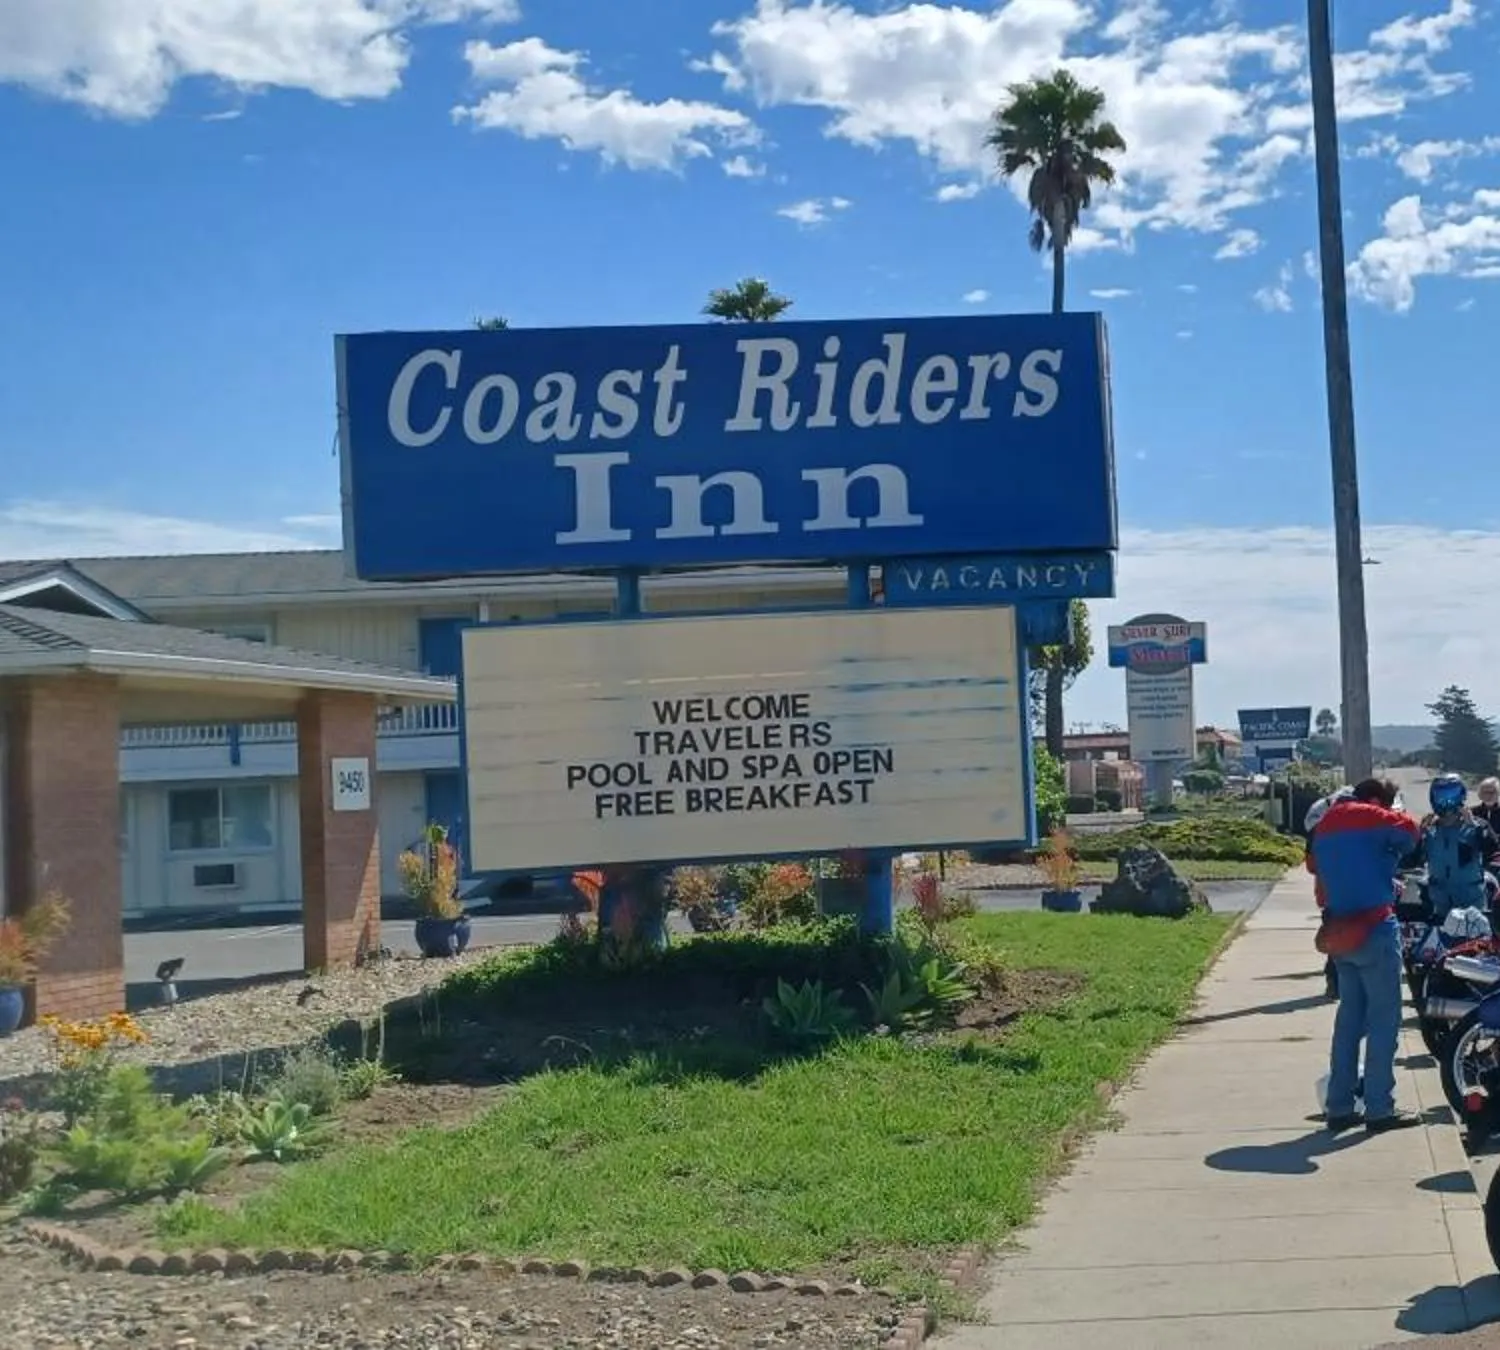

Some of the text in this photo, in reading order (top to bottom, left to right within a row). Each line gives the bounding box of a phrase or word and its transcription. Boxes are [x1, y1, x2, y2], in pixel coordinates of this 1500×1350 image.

[387, 333, 1063, 448] Coast Riders
[554, 451, 925, 545] Inn
[901, 560, 1096, 591] VACANCY
[652, 693, 811, 725] WELCOME
[634, 721, 833, 756] TRAVELERS
[567, 748, 895, 790] POOL AND SPA OPEN
[595, 778, 876, 819] FREE BREAKFAST
